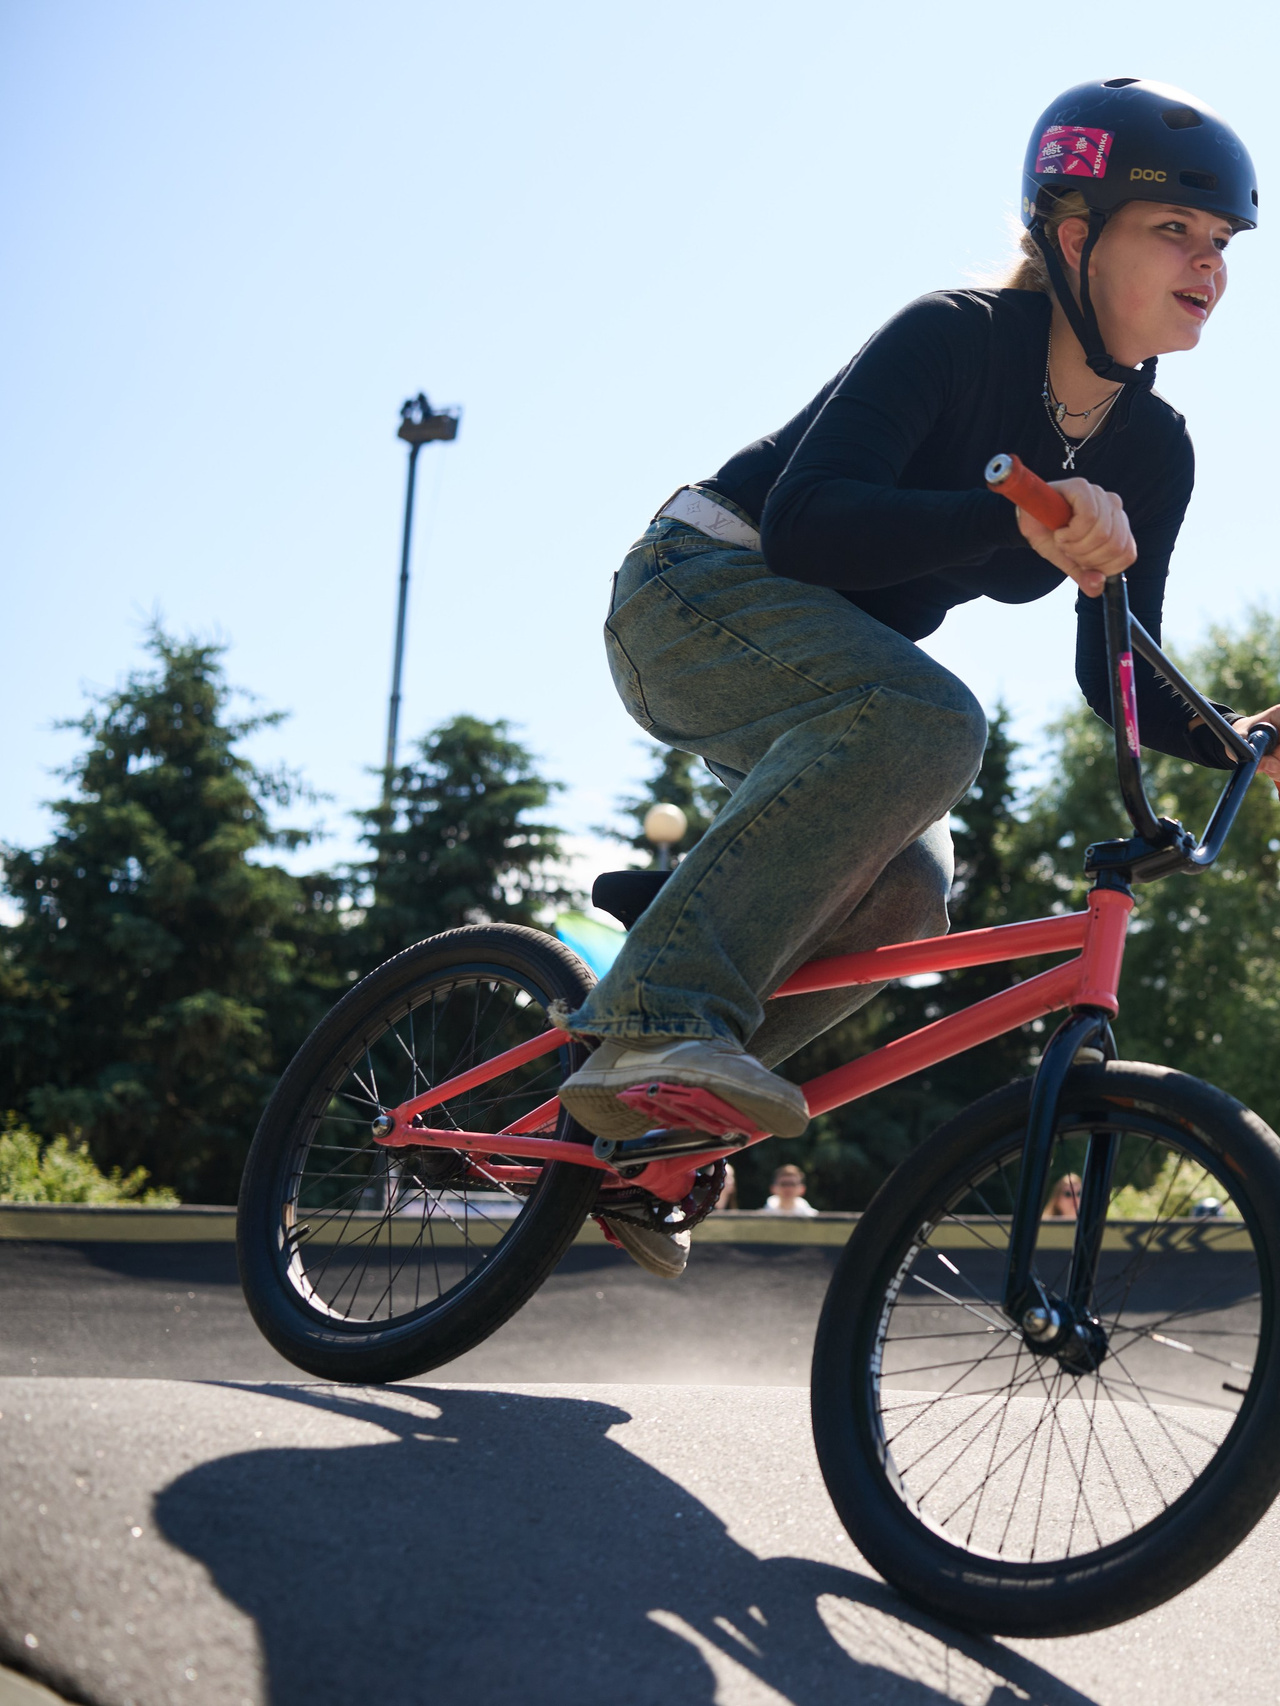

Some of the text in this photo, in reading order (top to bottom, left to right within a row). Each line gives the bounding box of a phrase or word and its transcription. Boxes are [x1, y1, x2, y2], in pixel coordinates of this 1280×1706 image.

[1046, 140, 1058, 149] VK
[1042, 145, 1062, 156] fest
[1092, 133, 1109, 175] ТЕХНИКА
